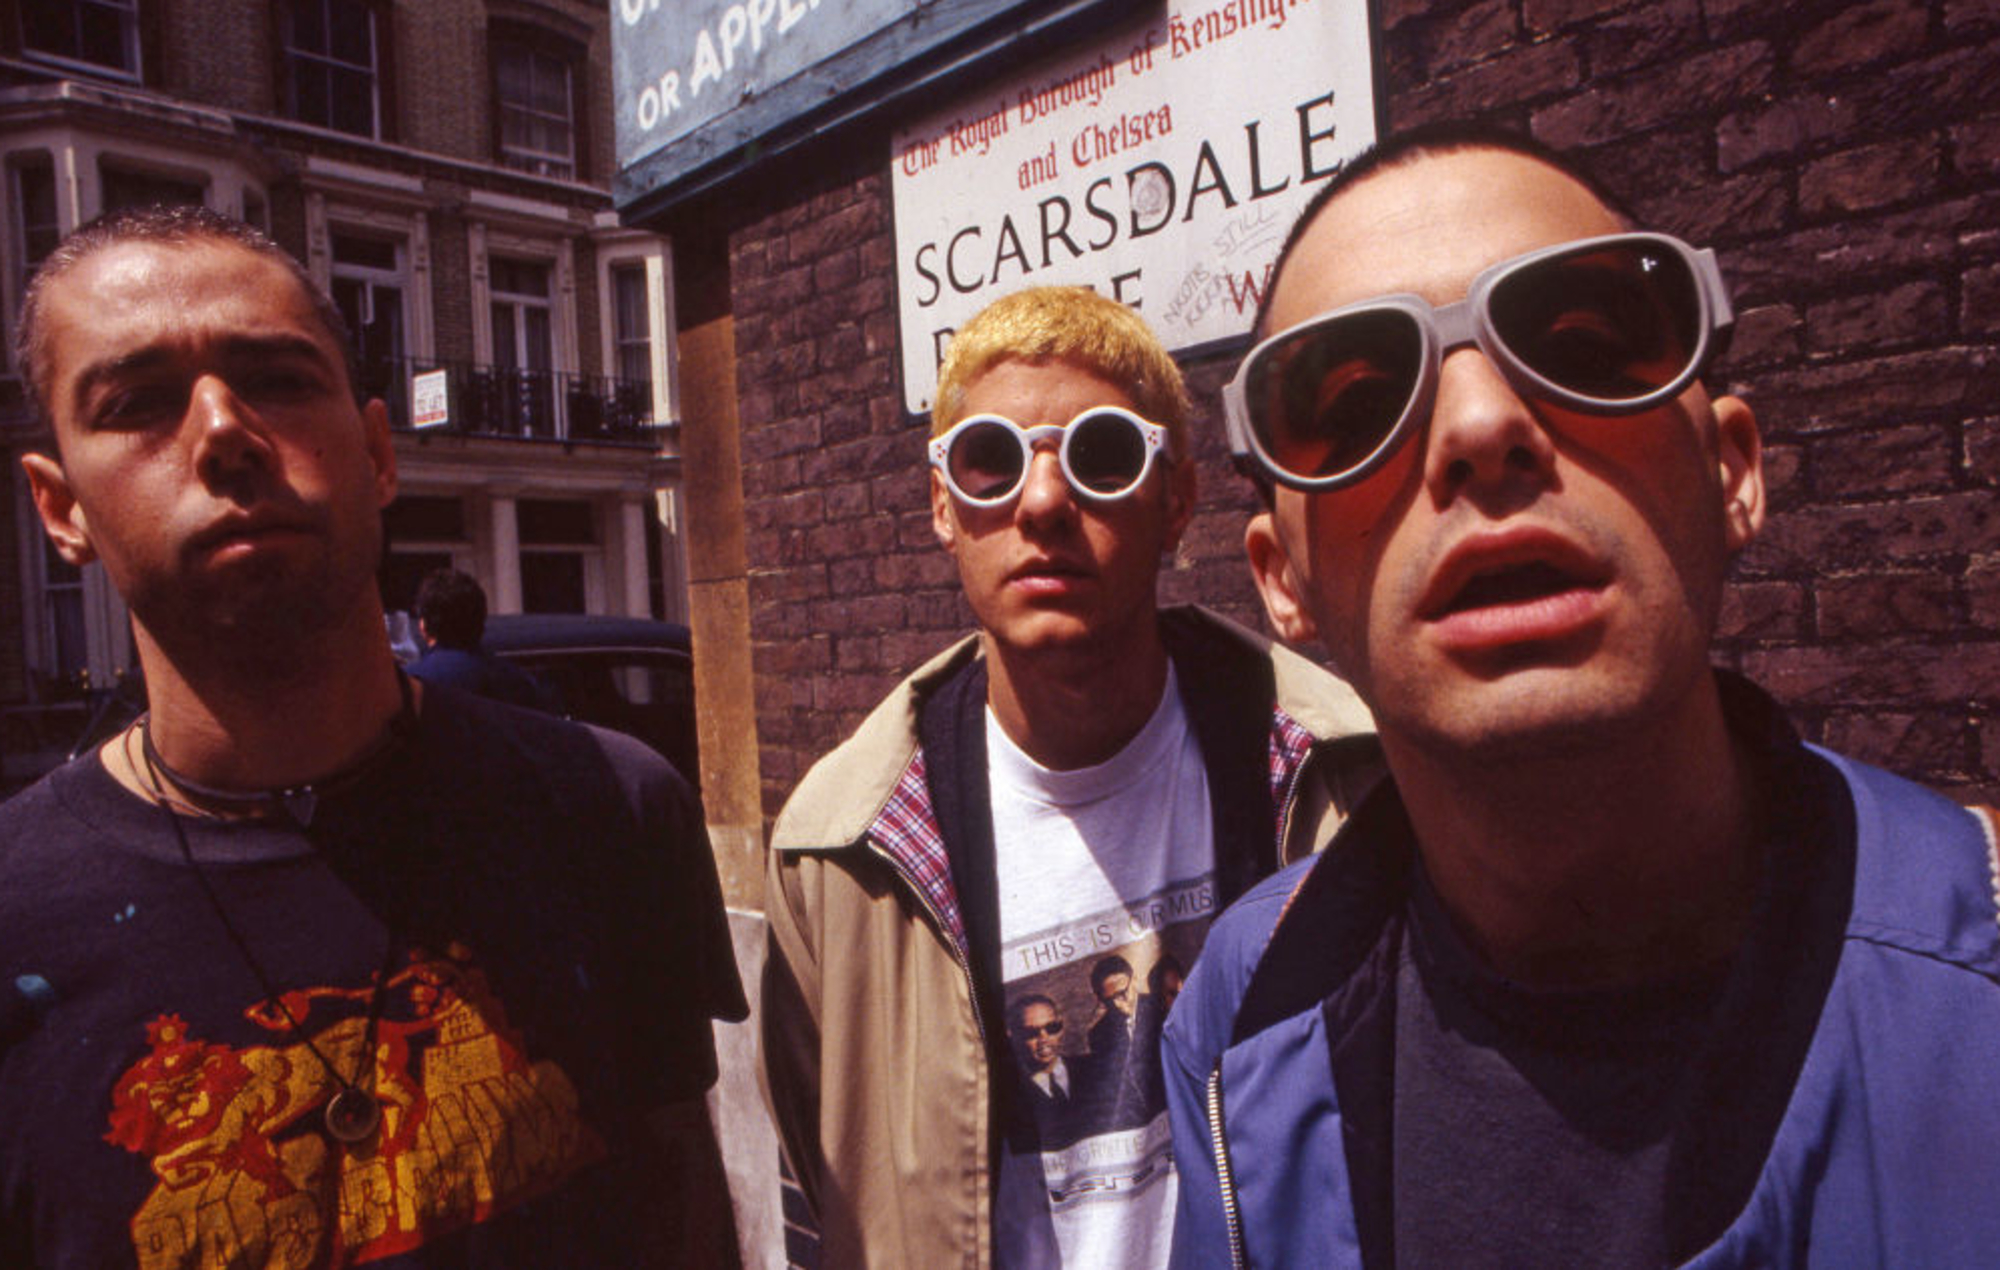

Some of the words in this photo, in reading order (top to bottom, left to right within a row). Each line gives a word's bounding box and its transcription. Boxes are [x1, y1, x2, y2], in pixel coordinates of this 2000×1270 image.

[638, 70, 681, 131] OR
[690, 0, 820, 98] APPL
[902, 139, 941, 177] The
[947, 101, 1008, 156] Royal
[1018, 53, 1115, 126] Borough
[1130, 30, 1158, 76] of
[1168, 0, 1310, 60] Kensing
[914, 90, 1343, 308] SCARSDALE
[1017, 141, 1059, 190] and
[1072, 103, 1173, 168] Chelsea
[1017, 935, 1076, 971] THIS
[1090, 923, 1114, 949] IS
